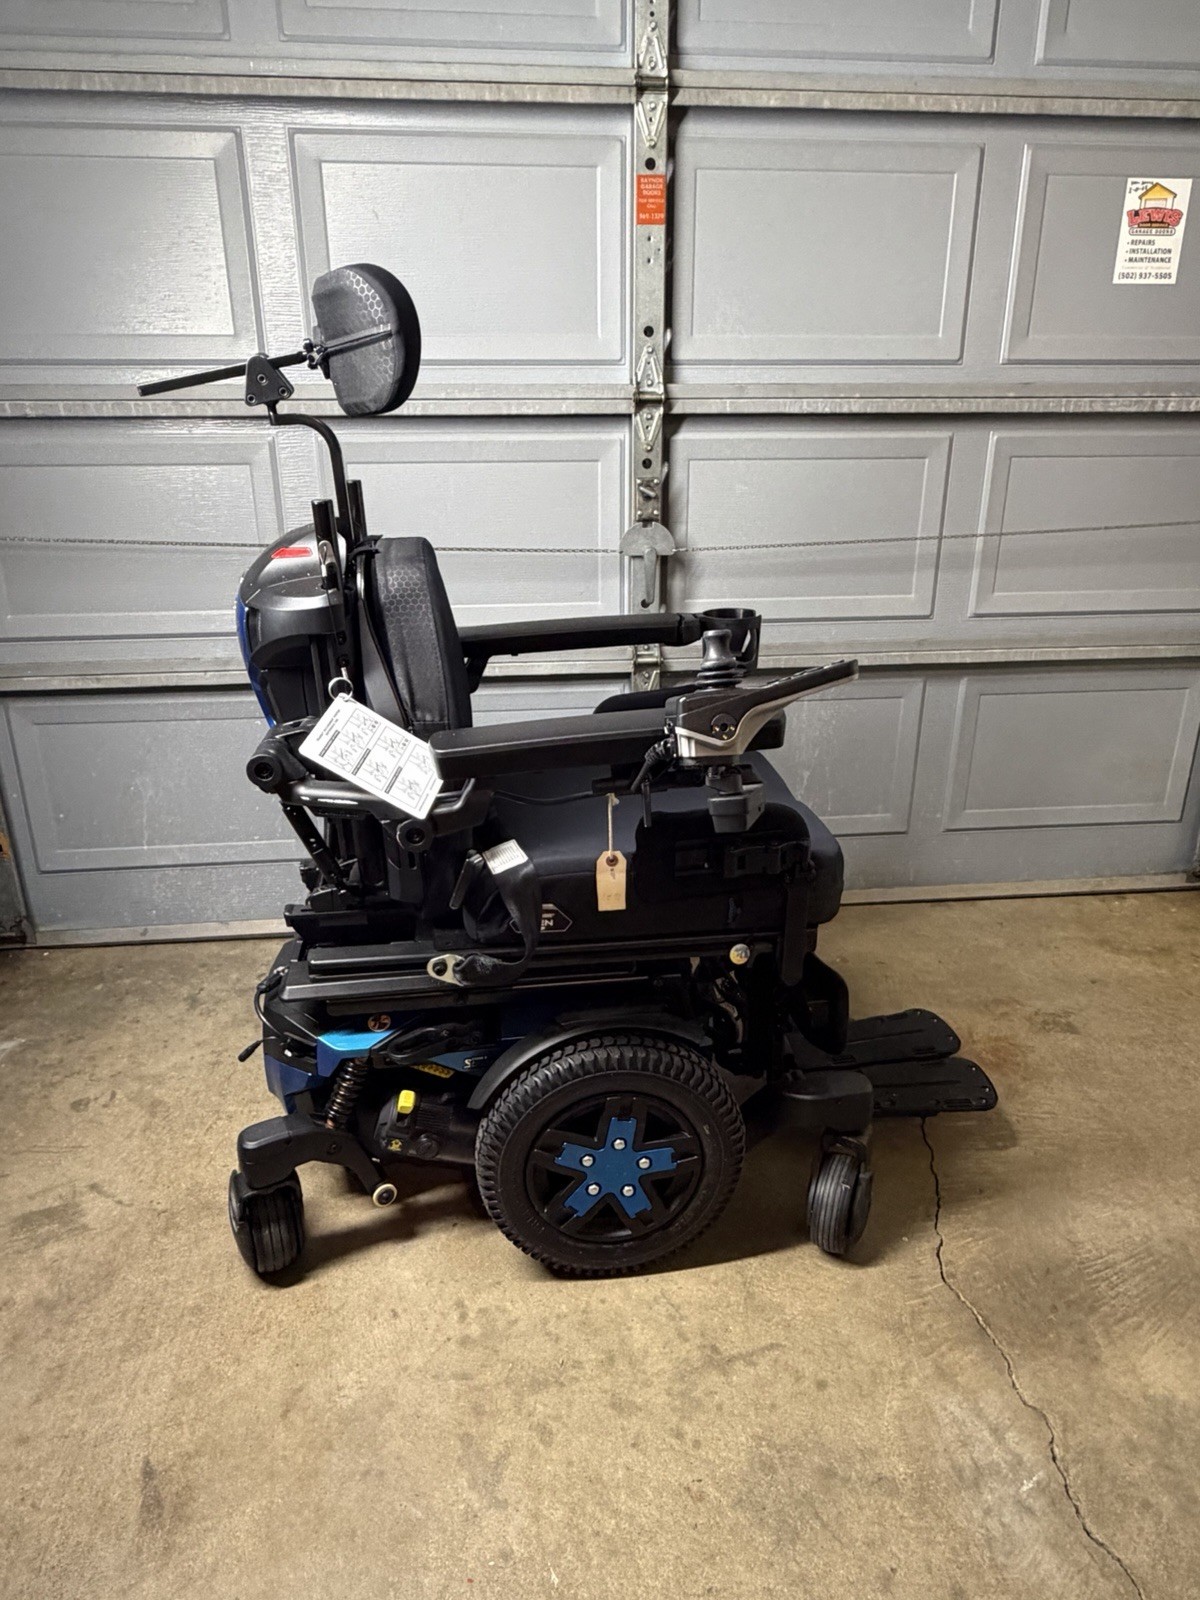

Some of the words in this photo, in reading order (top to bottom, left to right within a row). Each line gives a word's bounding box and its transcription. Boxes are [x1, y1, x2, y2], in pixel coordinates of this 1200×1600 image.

[1127, 207, 1184, 227] LEWIS
[1118, 272, 1137, 280] (502)
[1138, 272, 1172, 280] 937-5505
